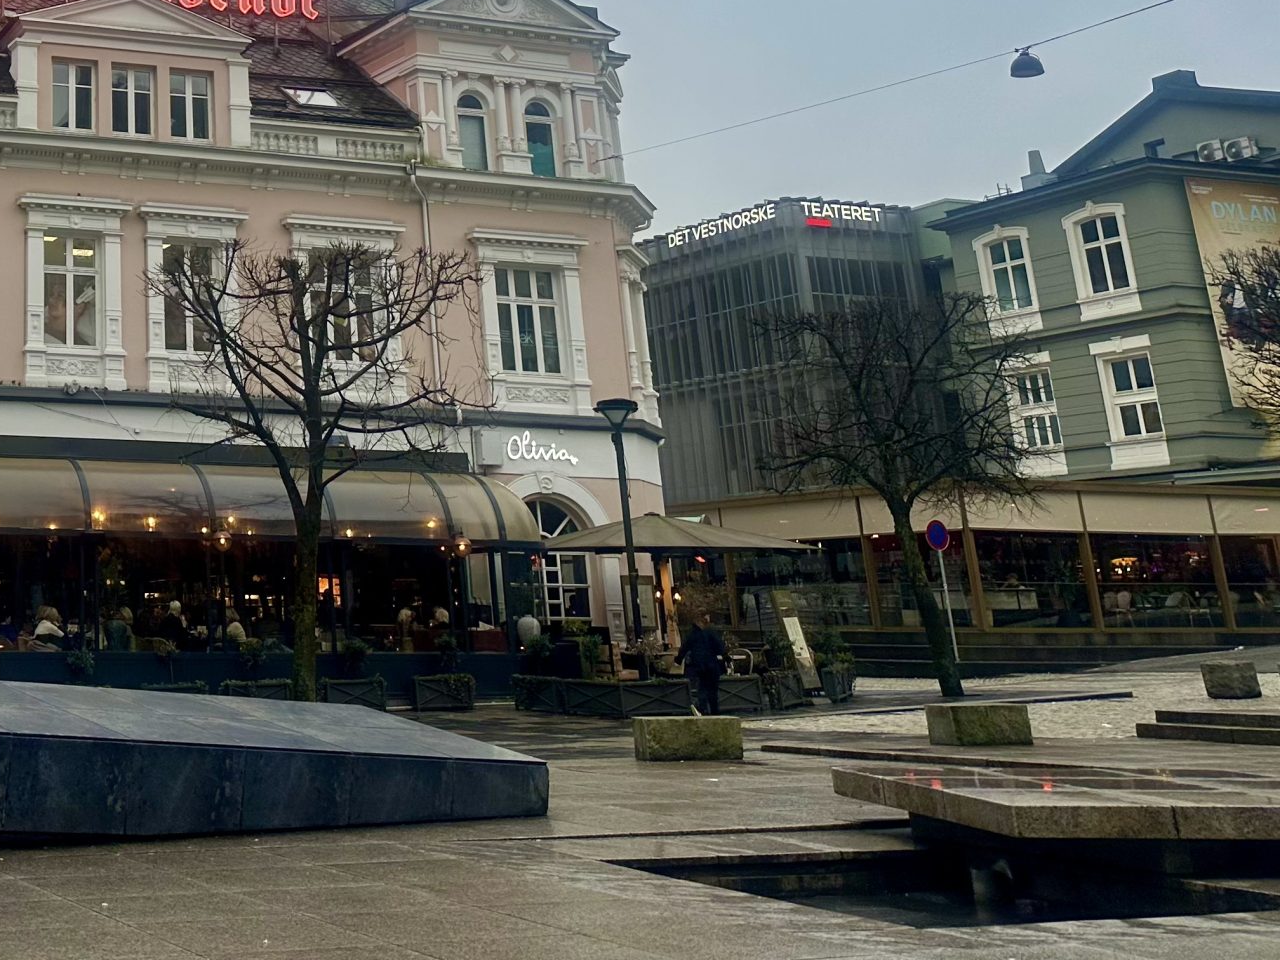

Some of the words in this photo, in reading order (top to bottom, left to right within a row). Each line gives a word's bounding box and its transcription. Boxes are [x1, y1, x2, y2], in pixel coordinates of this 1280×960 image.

[800, 200, 882, 223] TEATERET
[1210, 200, 1278, 224] DYLAN
[668, 228, 690, 249] DET
[692, 203, 776, 240] VESTNORSKE
[507, 430, 574, 463] Olivia
